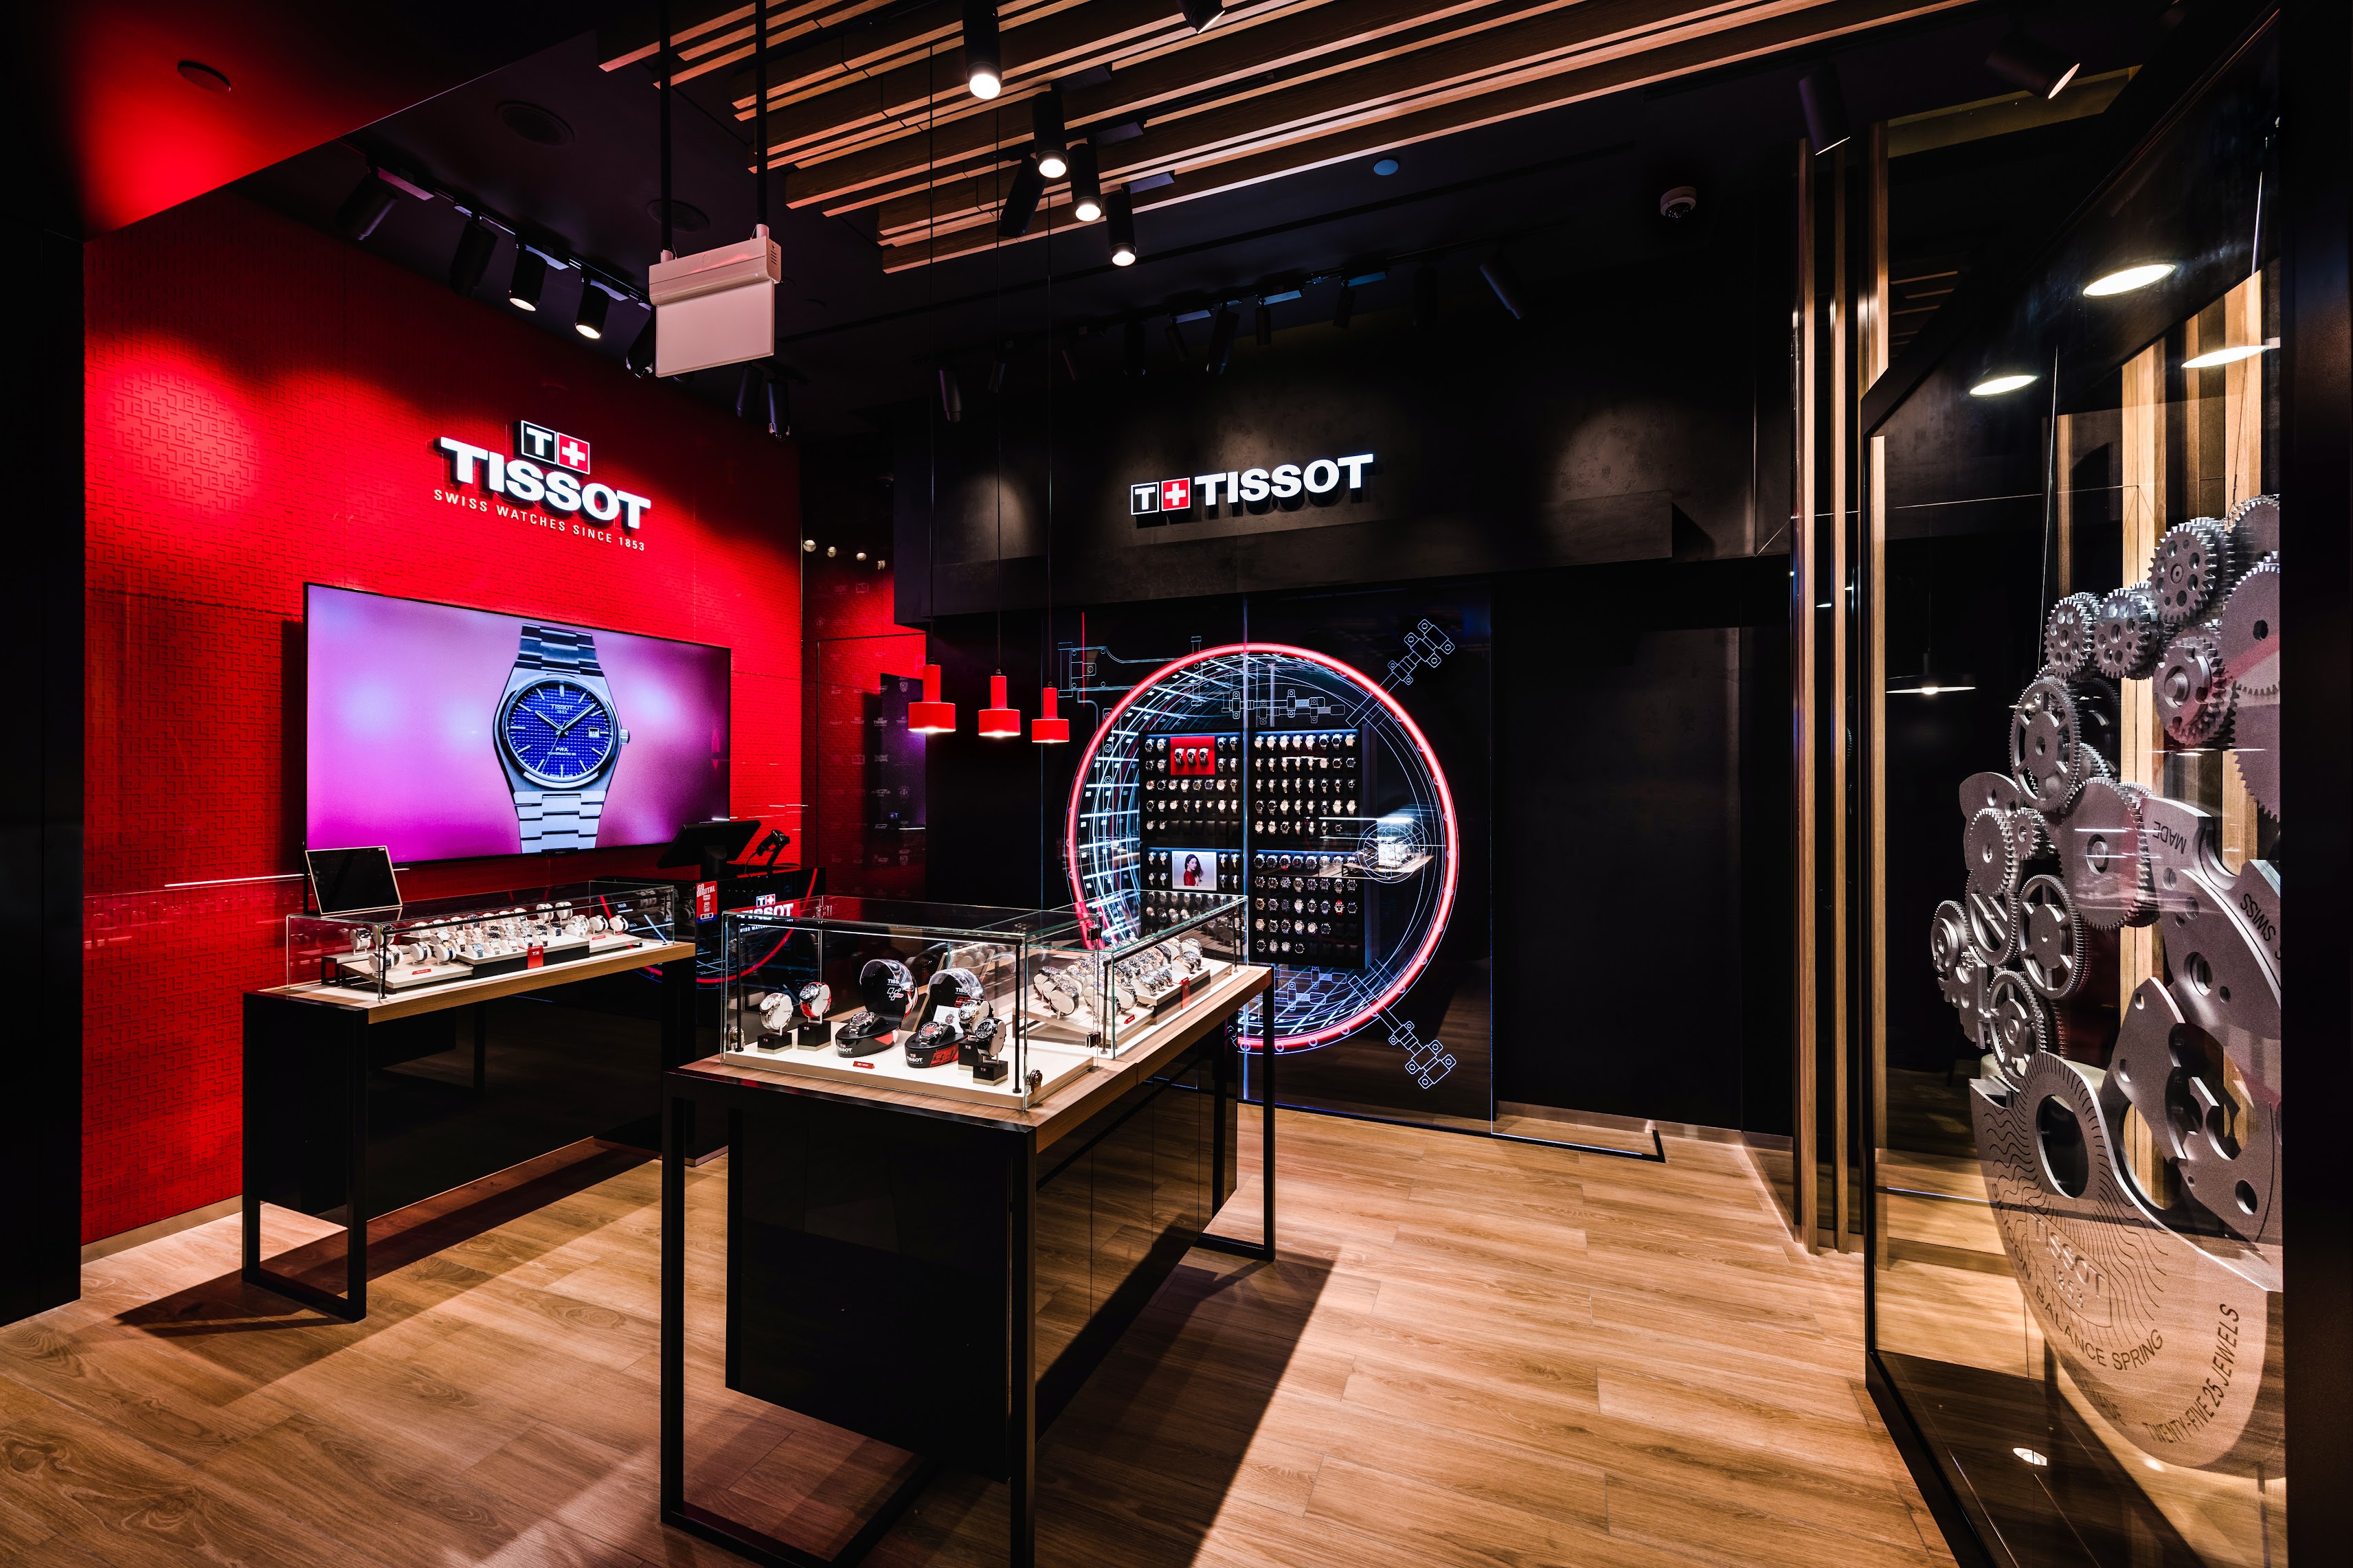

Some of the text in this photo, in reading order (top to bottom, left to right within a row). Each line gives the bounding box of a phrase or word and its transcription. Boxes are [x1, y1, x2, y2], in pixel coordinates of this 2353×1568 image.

[440, 436, 651, 529] TISSOT
[1194, 453, 1374, 506] TISSOT
[434, 489, 645, 552] SWISS WATCHES SINCE 1853
[696, 885, 716, 898] DIGITAL
[2152, 821, 2276, 942] SWISS MADE
[2051, 1264, 2084, 1308] 1853
[2035, 1284, 2107, 1367] BALANCE
[2111, 1328, 2163, 1371] SPRING
[2142, 1304, 2240, 1443] TWENTY-FIVE 25 JEWELS
